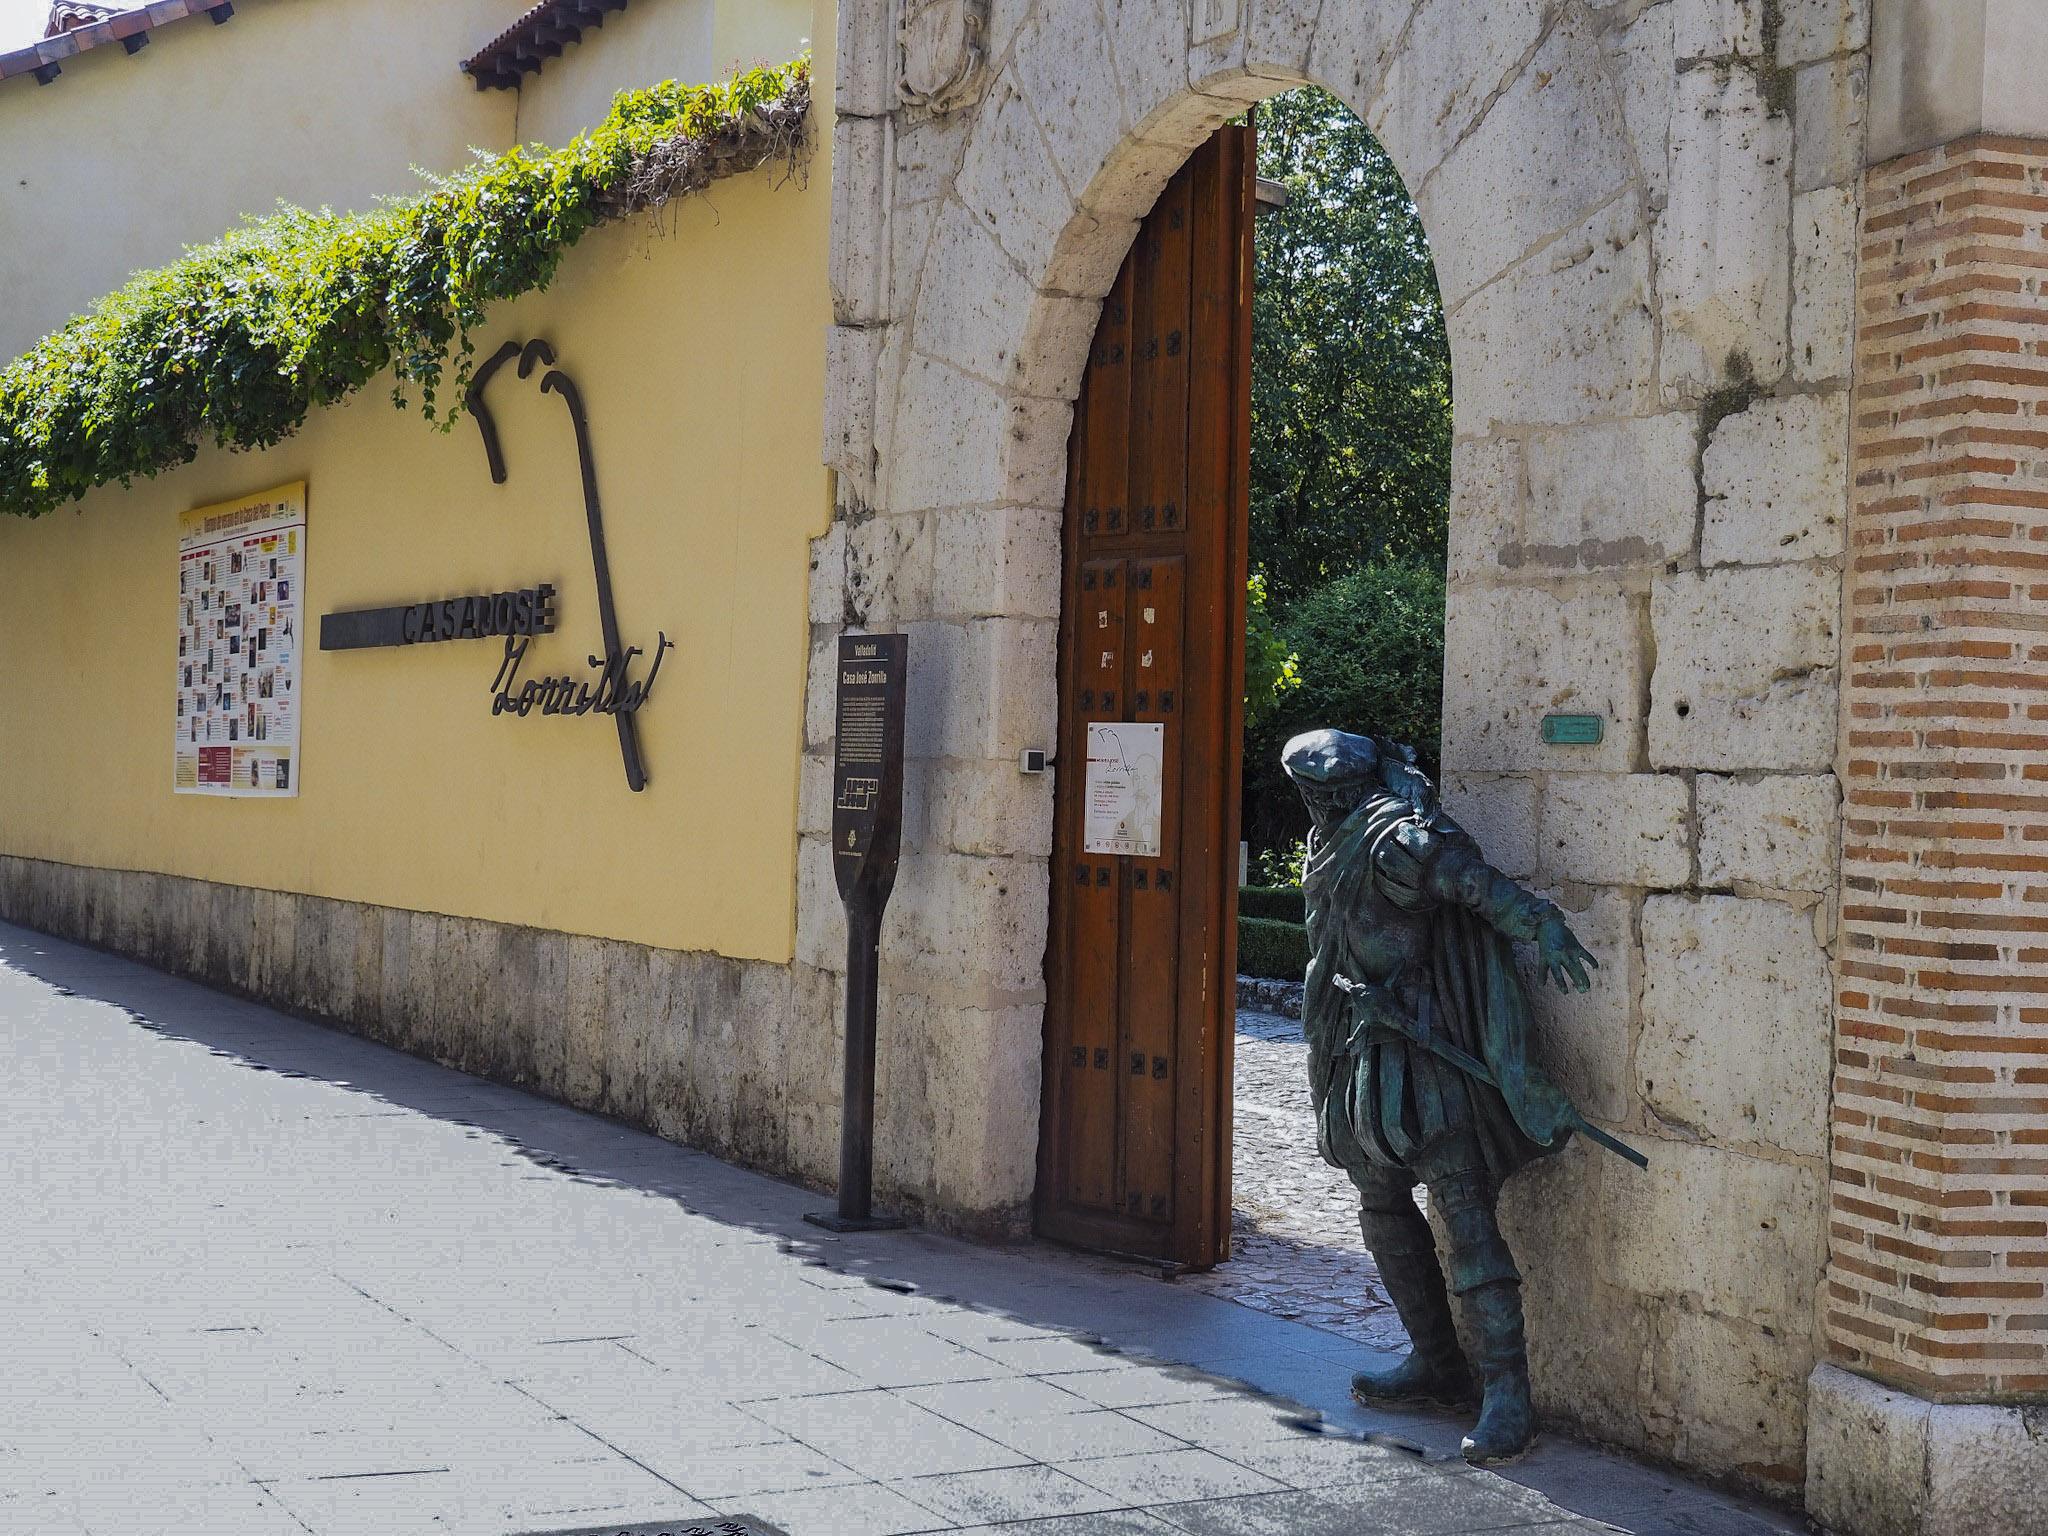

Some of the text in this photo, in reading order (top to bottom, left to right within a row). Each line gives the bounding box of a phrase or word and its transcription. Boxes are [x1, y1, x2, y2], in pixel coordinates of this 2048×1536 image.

[854, 644, 877, 656] Valladolid
[842, 670, 887, 684] Casa José Zorrilla
